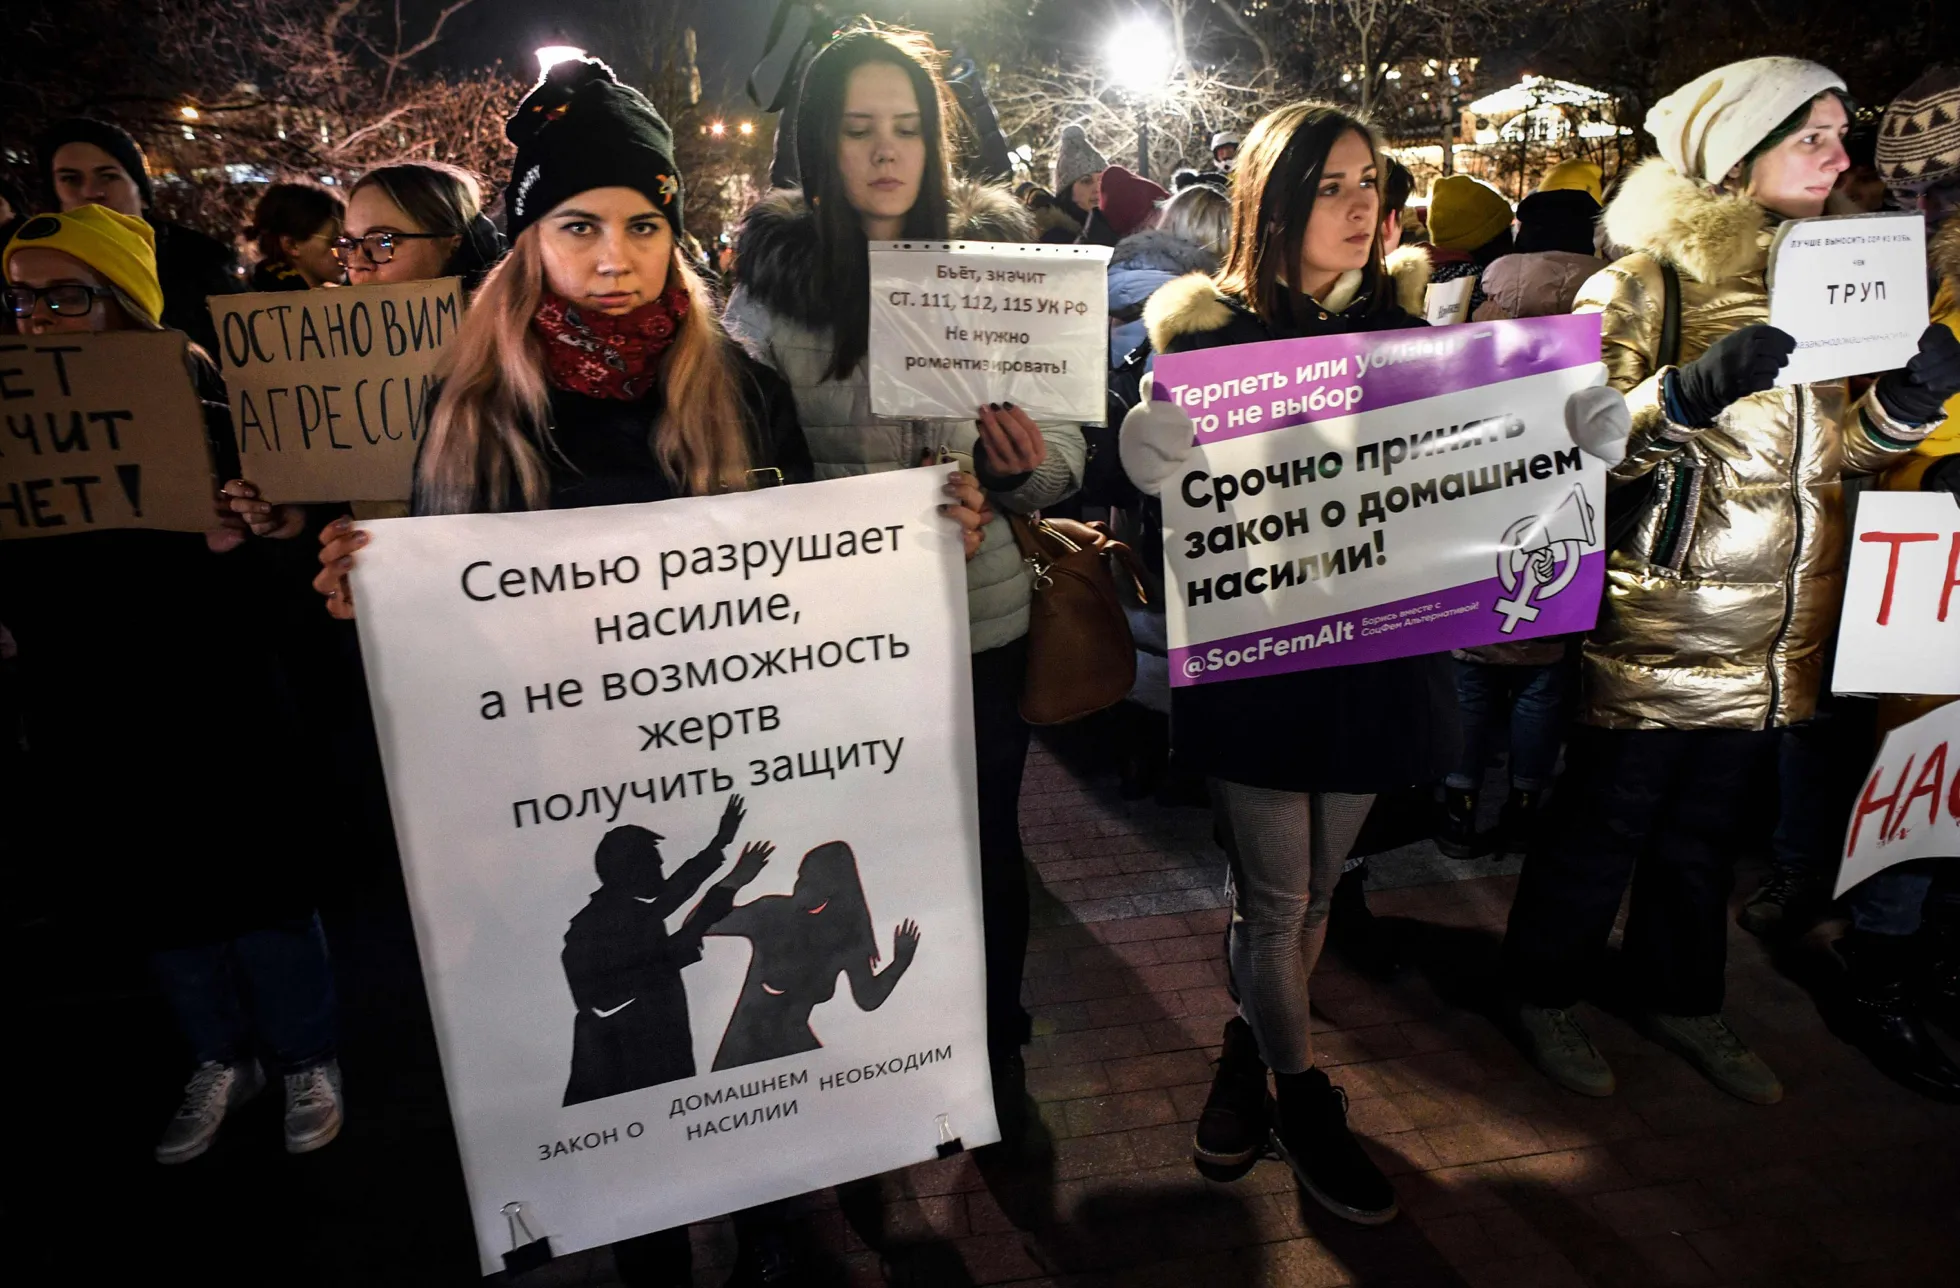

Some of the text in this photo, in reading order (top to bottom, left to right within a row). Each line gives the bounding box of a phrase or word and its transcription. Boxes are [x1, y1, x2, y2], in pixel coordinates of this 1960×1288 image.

[936, 264, 1047, 285] Бьёт, значит
[1827, 281, 1887, 305] ТРУП
[222, 291, 458, 368] ОСТАНОВИМ
[921, 293, 957, 311] 111,
[962, 295, 997, 313] 112,
[1003, 298, 1033, 312] 115
[1036, 299, 1060, 314] УК
[1064, 300, 1089, 316] РФ
[945, 326, 1030, 346] Не нужно
[905, 356, 1068, 375] романтизировать!
[1170, 371, 1288, 409] Терпеть
[1296, 357, 1348, 384] или
[0, 410, 134, 457] ЧИТ
[240, 373, 433, 452] АГРЕССИ
[1190, 385, 1364, 435] то не выбор
[1181, 450, 1344, 513] Срочно
[1184, 445, 1584, 560] закон о домашнем
[460, 524, 905, 602] Семью разрушает
[1187, 529, 1388, 607] насилии!
[595, 592, 801, 646] насилие,
[1360, 621, 1402, 637] СоцФем
[1361, 613, 1398, 627] Борись
[1399, 604, 1434, 618] вместе
[1182, 620, 1355, 680] @SocFemAlt
[480, 632, 911, 721] а не возможность
[638, 703, 781, 752] жертв
[512, 736, 905, 828] получить защиту
[538, 1044, 954, 1162] ЗАКОН О ДОМАШНЕМ НЕОБХОДИМ
[686, 1098, 800, 1141] НАСИЛИИ
